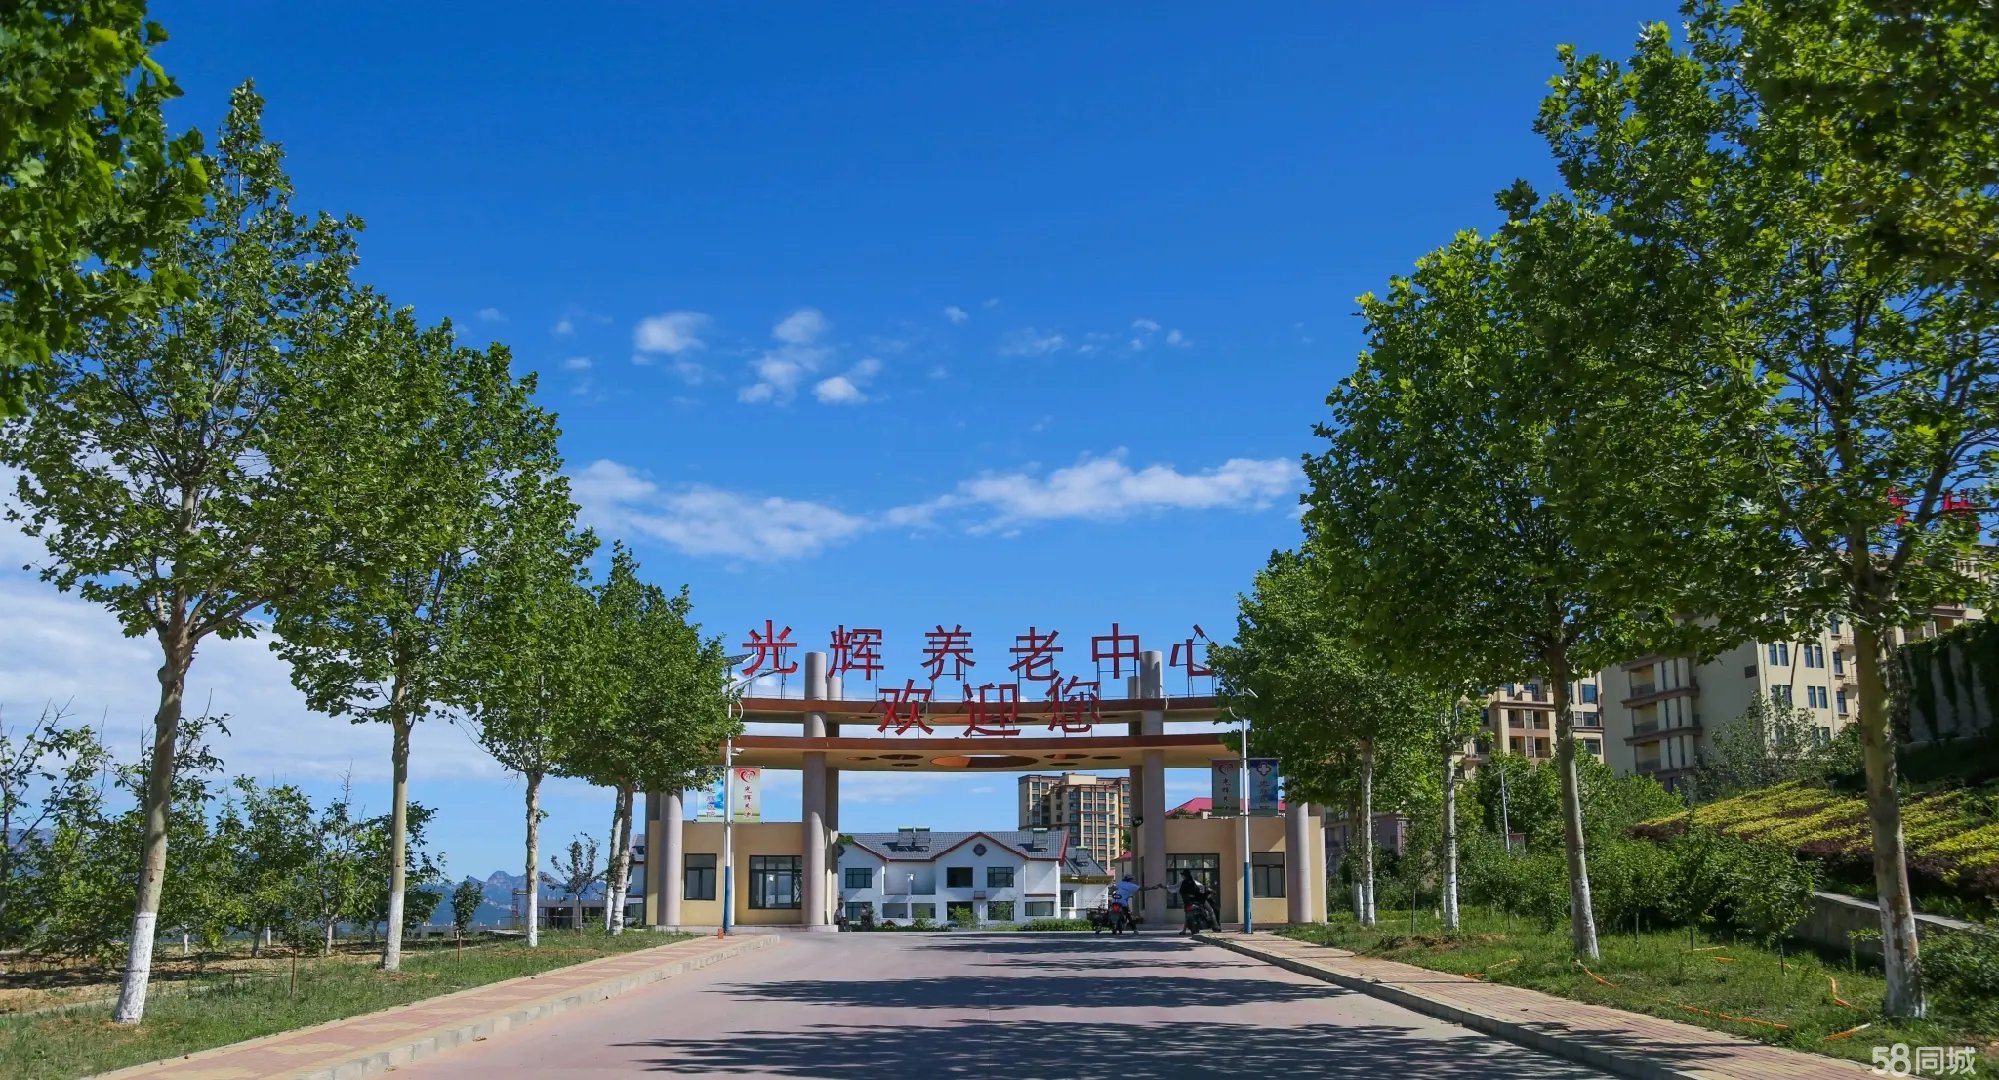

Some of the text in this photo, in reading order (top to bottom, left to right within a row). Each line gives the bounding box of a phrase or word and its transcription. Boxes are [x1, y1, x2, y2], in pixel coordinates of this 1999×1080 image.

[741, 619, 1214, 682] 光辉养老中心
[878, 675, 1101, 738] 欢迎您
